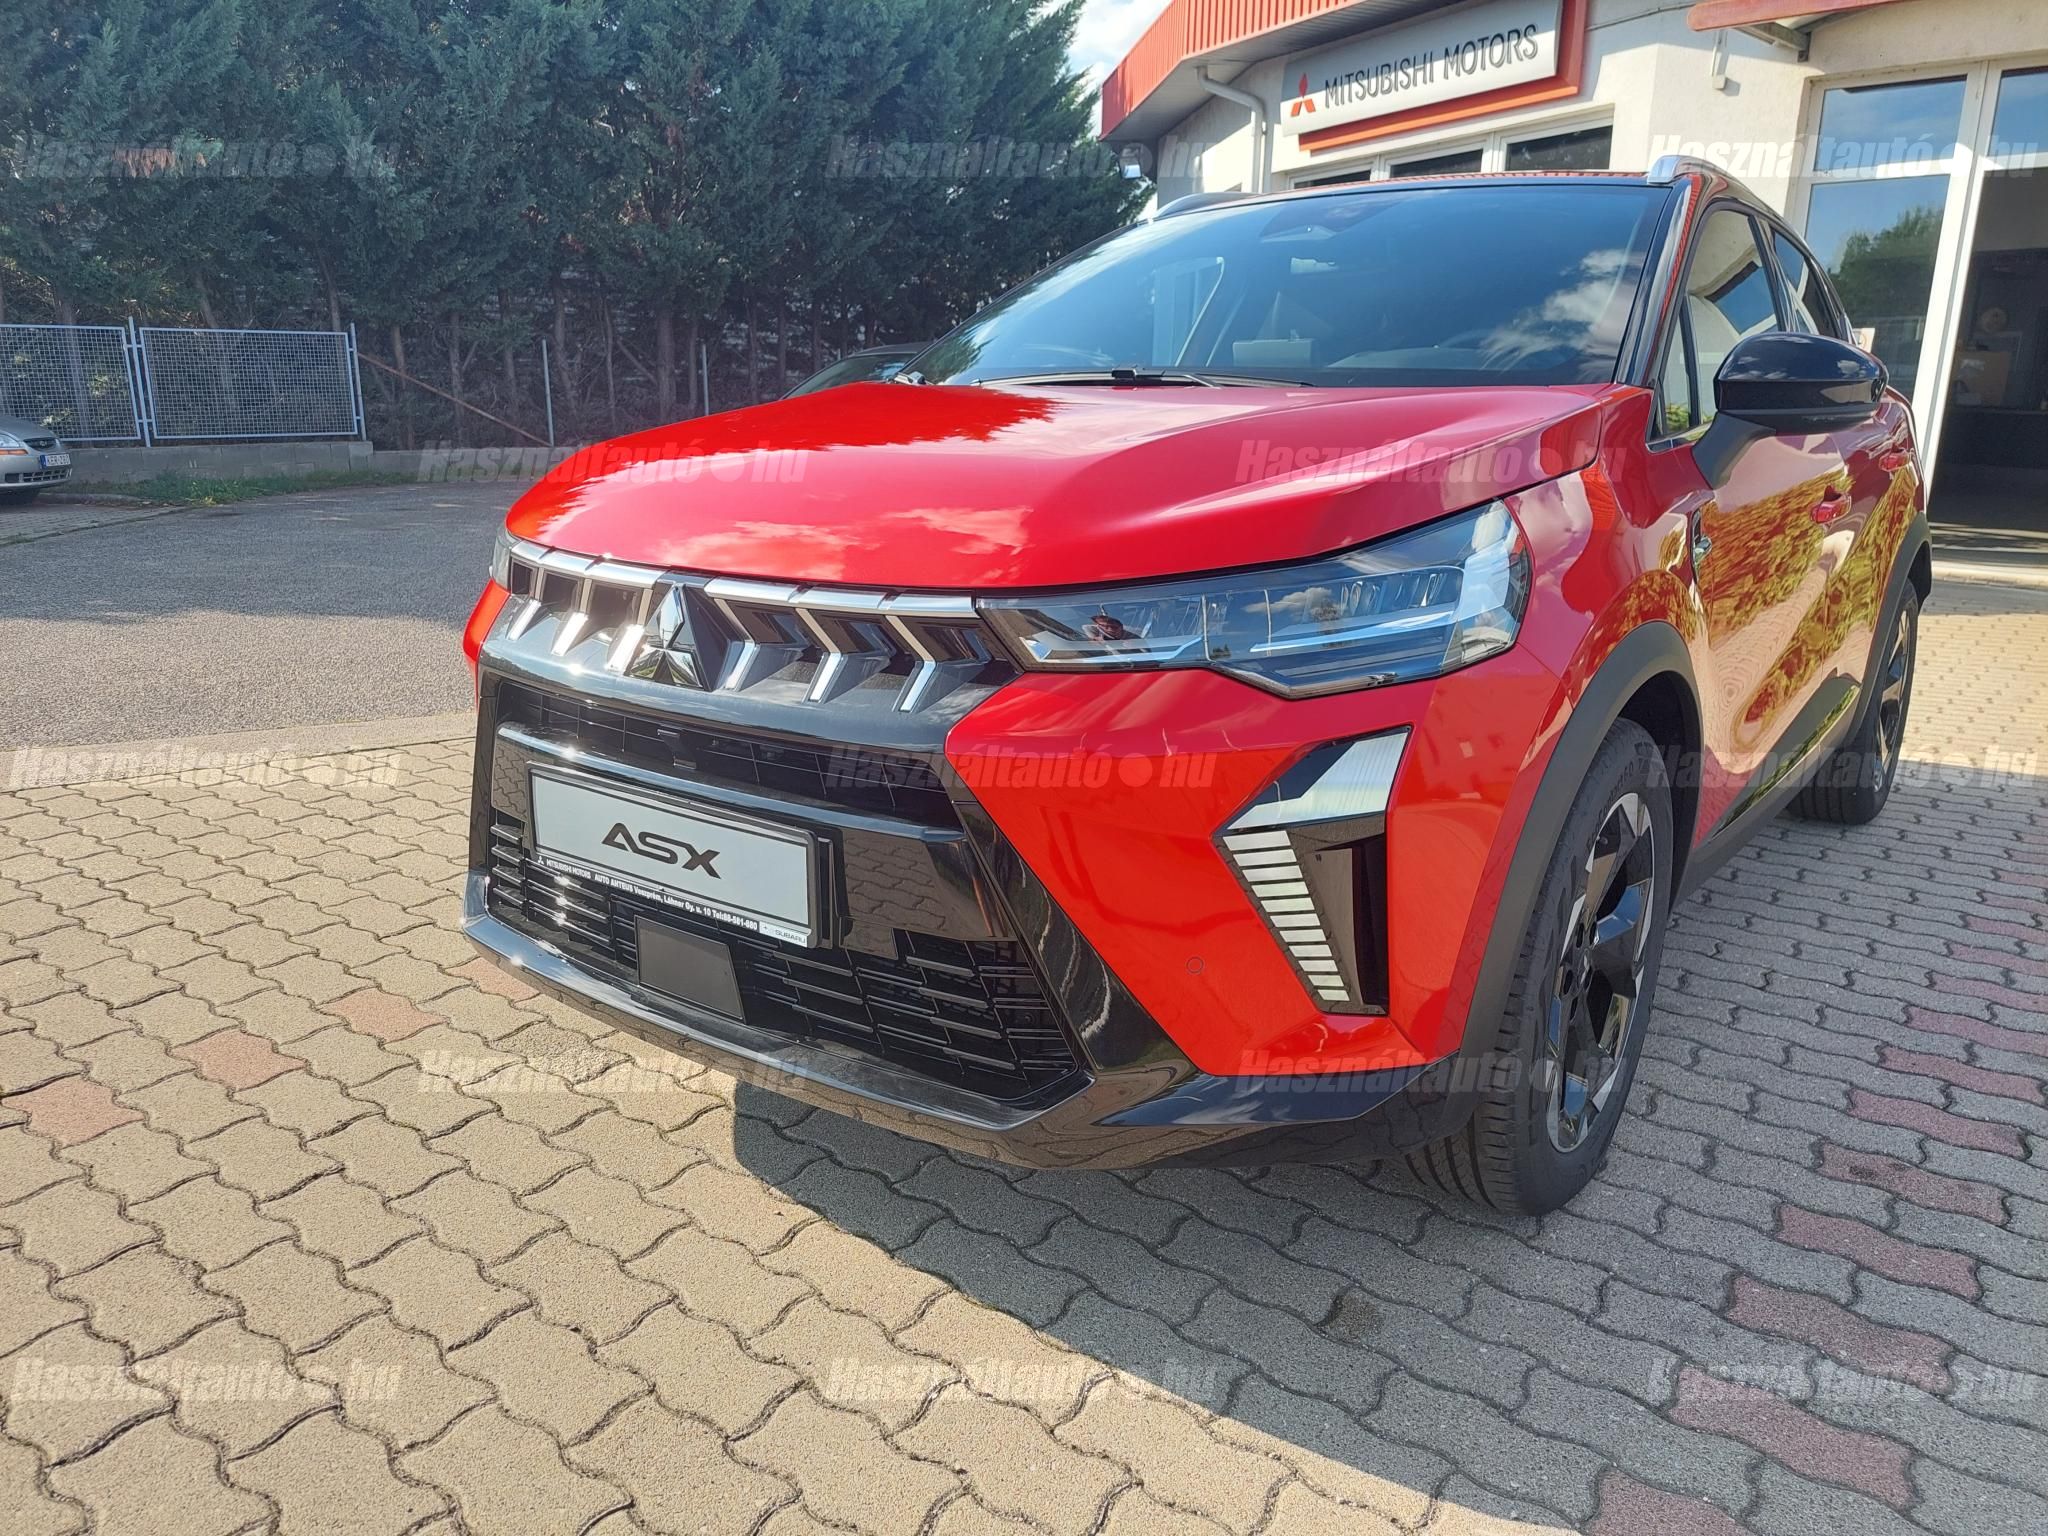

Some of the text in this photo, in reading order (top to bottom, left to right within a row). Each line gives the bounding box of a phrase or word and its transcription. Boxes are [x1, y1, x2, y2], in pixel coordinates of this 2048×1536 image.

[1325, 24, 1538, 109] MITSUBISHI MOTORS
[601, 822, 722, 880] ASX
[594, 873, 610, 885] AUTO
[703, 908, 712, 917] 10
[775, 929, 806, 944] SUBARU
